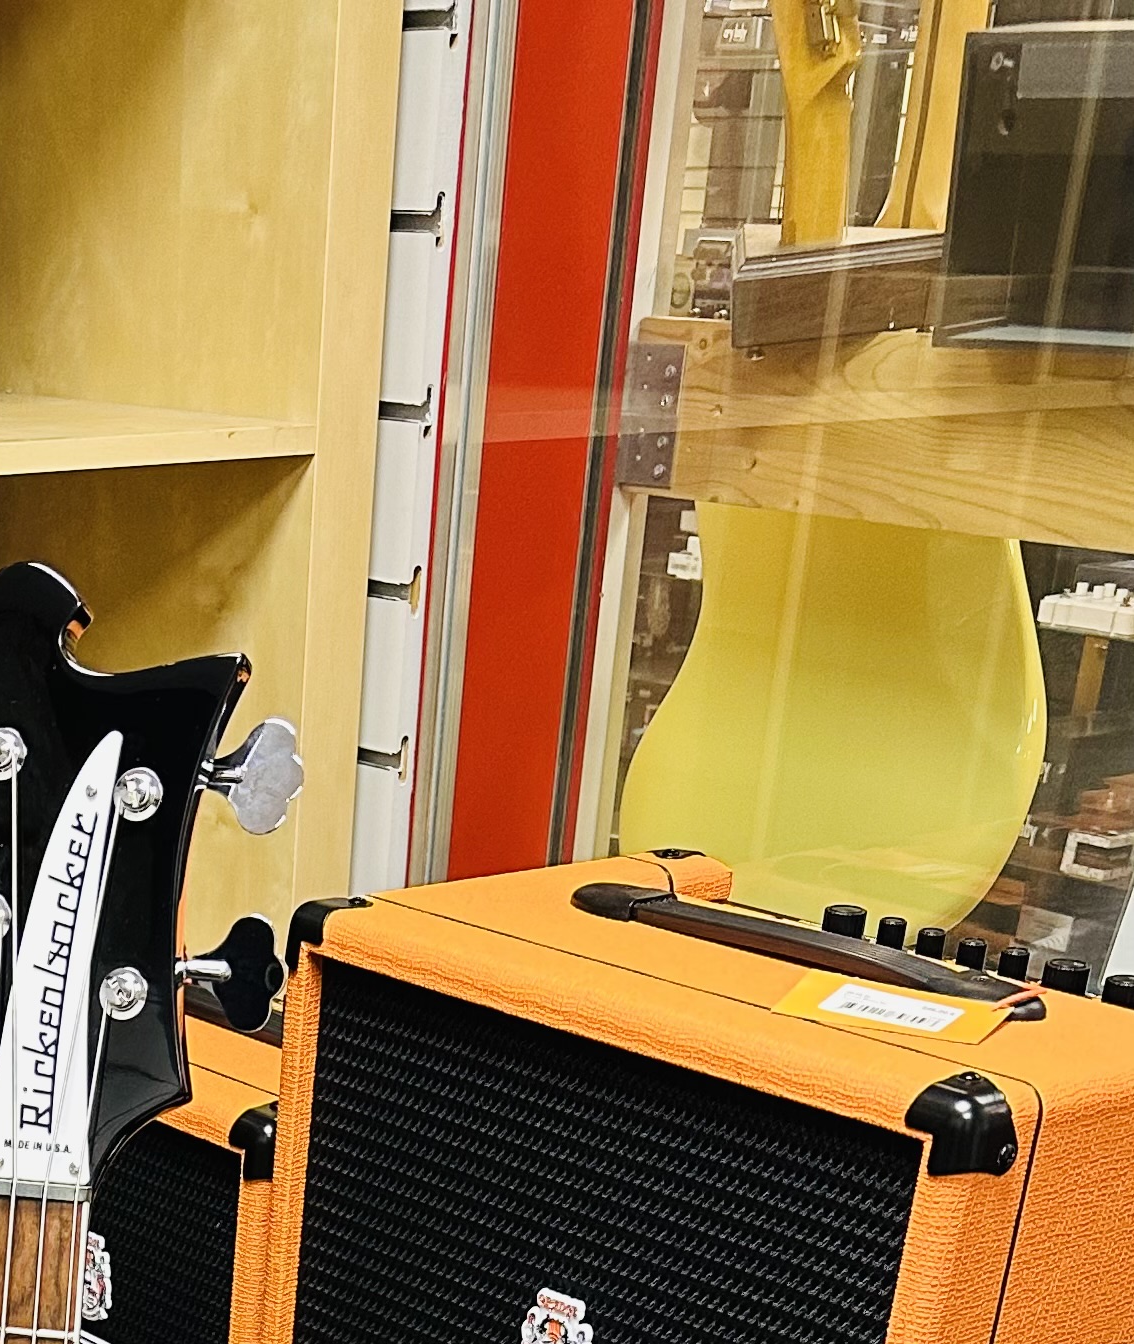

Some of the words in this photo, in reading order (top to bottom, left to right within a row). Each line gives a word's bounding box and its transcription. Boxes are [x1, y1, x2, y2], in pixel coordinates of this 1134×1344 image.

[19, 811, 99, 1135] Rickenbacker
[3, 1138, 31, 1151] MDE
[33, 1141, 43, 1151] IN
